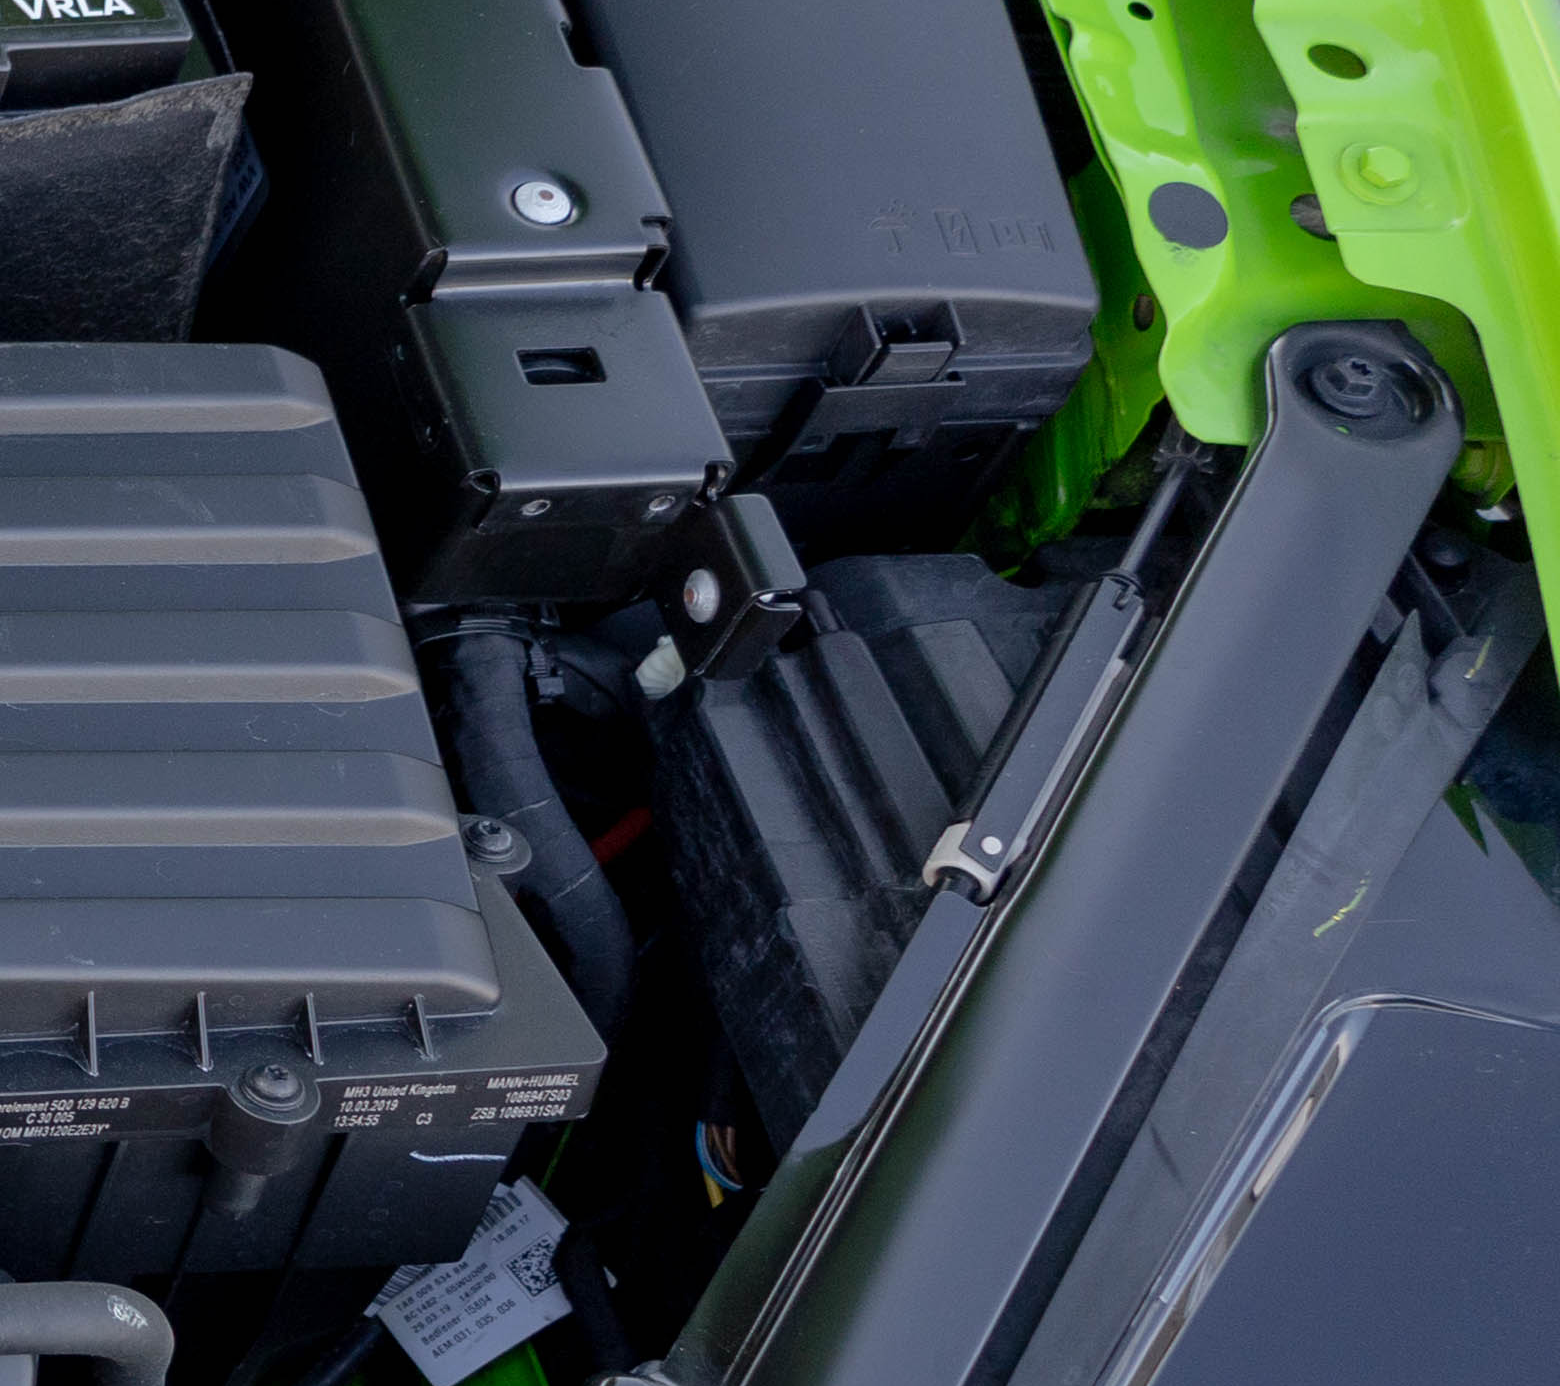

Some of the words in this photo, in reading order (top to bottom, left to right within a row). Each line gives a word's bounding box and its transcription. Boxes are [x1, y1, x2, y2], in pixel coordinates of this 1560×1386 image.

[487, 1075, 579, 1089] MANN+HUMMEL
[373, 1086, 407, 1097] United
[410, 1084, 456, 1098] Kingdom
[77, 1099, 96, 1110] 129
